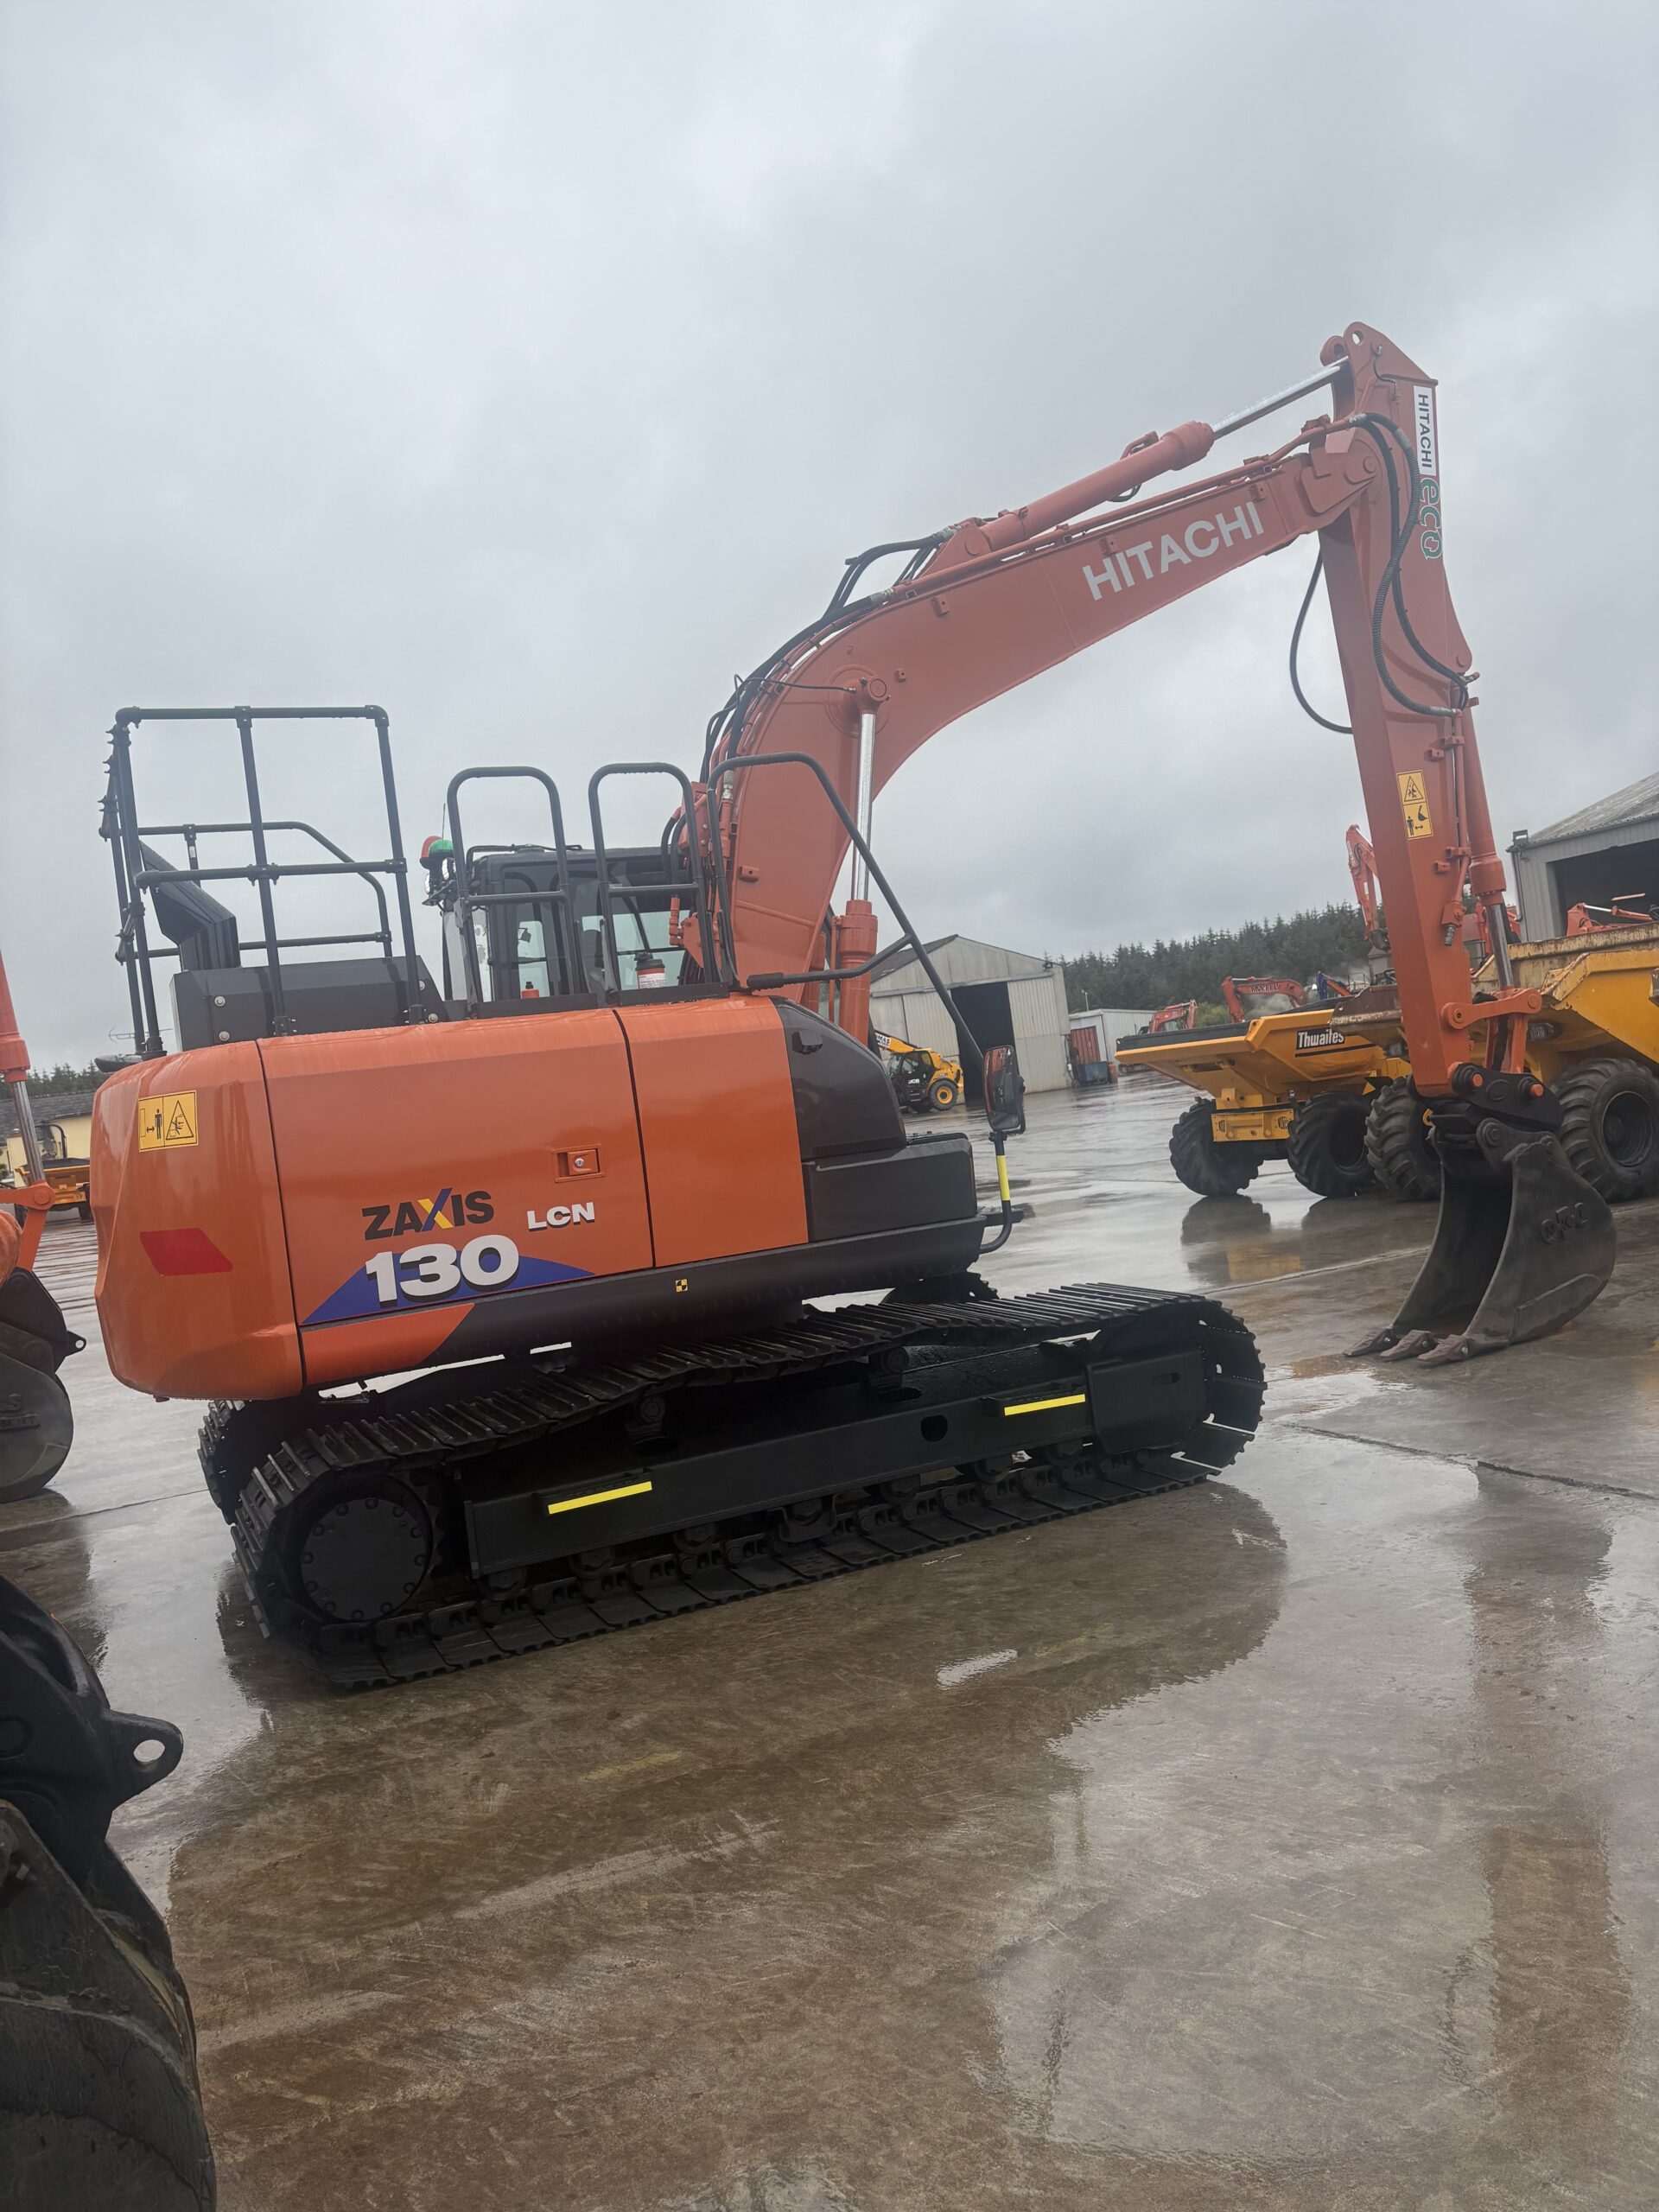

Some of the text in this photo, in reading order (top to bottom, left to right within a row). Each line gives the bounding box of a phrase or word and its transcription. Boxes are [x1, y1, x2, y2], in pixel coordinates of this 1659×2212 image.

[1418, 393, 1433, 468] HITACHI
[1082, 501, 1264, 601] HITACHI
[1298, 1028, 1344, 1048] Thwaites
[362, 1187, 494, 1241] ZAXIS
[526, 1202, 595, 1232] LCN
[365, 1235, 519, 1308] 130
